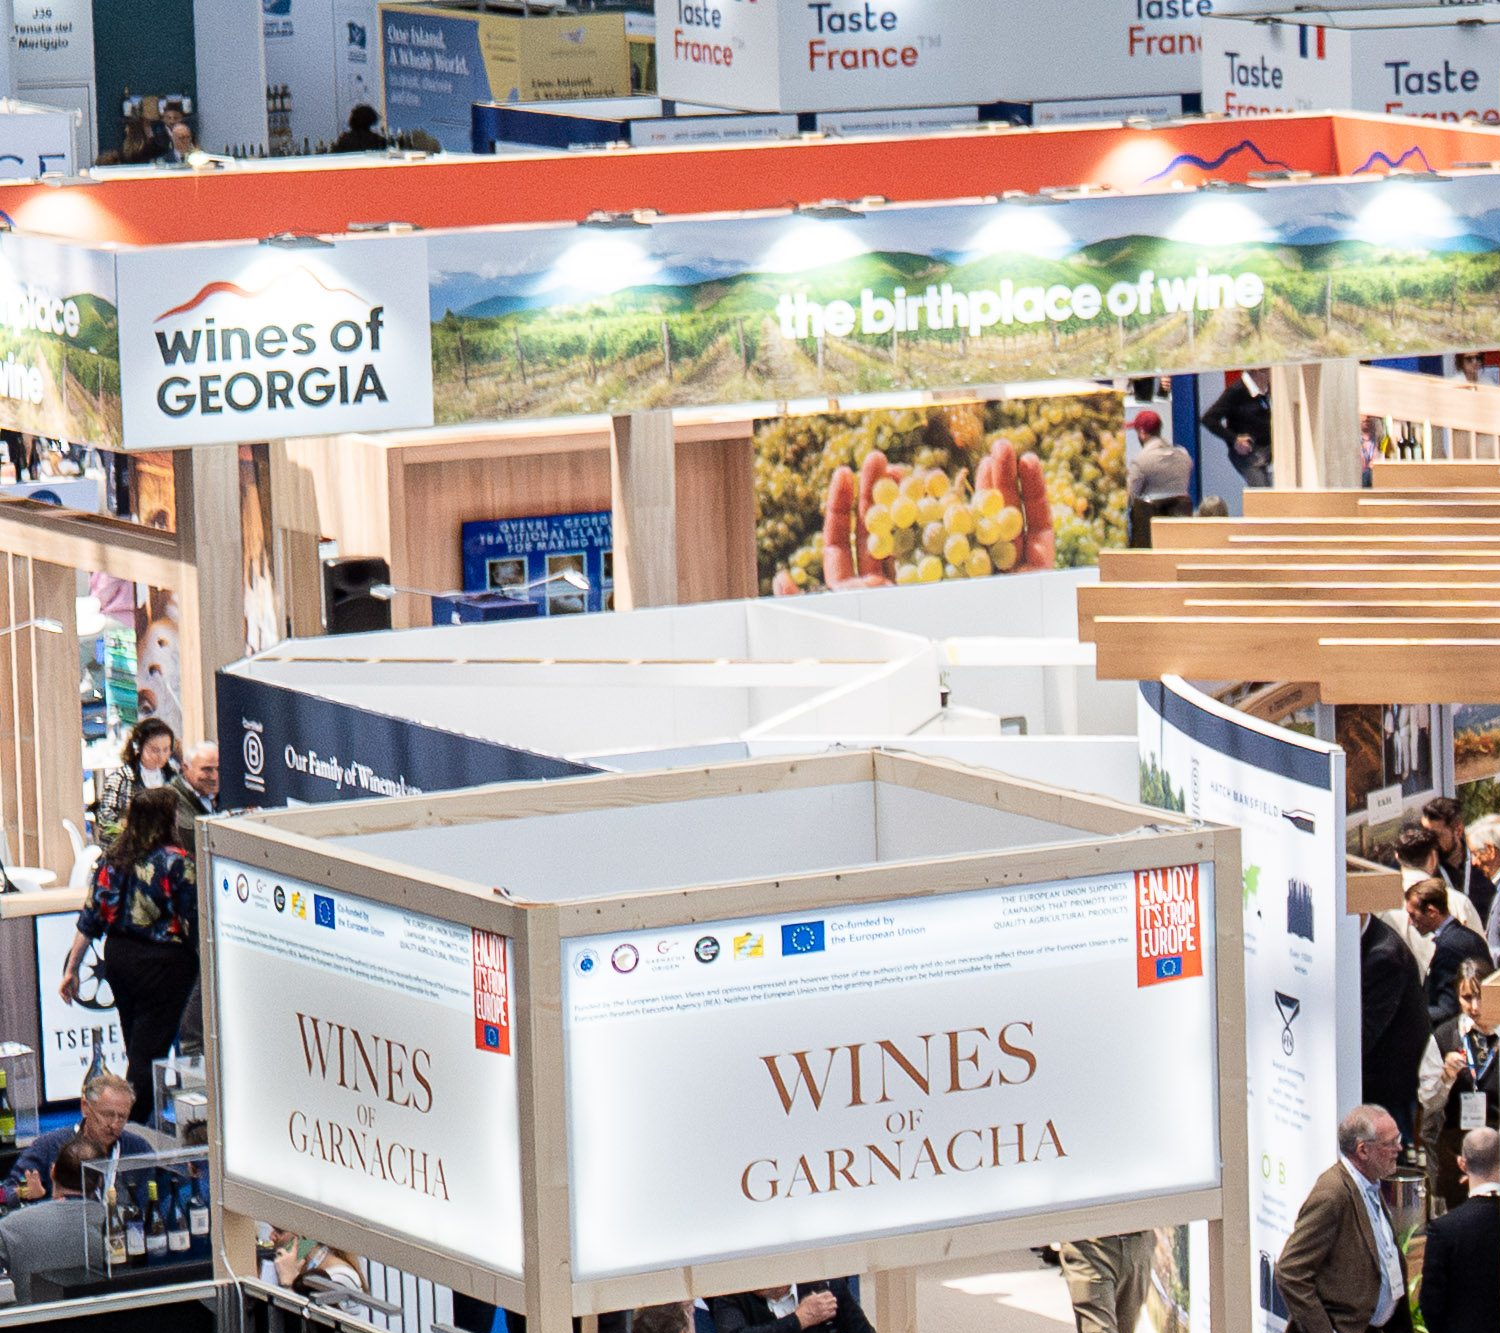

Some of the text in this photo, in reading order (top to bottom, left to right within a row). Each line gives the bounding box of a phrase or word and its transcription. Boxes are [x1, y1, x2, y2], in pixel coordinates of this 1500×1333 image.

[807, 2, 897, 34] Taste
[674, 29, 733, 67] France
[809, 39, 918, 71] France
[1225, 52, 1283, 89] Taste
[1384, 60, 1479, 96] Taste
[776, 267, 1264, 340] the birthplace of wine
[155, 304, 385, 366] wines of
[157, 363, 389, 419] GEORGIA
[309, 748, 344, 790] Family
[344, 760, 358, 788] of
[1138, 868, 1196, 907] ENJOY
[1139, 901, 1196, 930] IT'S FROM
[1140, 922, 1197, 959] EUROPE
[296, 1011, 433, 1114] WINES
[758, 1020, 1038, 1117] WINES
[356, 1104, 376, 1129] OF
[886, 1108, 925, 1134] OF
[289, 1110, 450, 1202] GARNACHA
[741, 1118, 1070, 1203] GARNACHA
